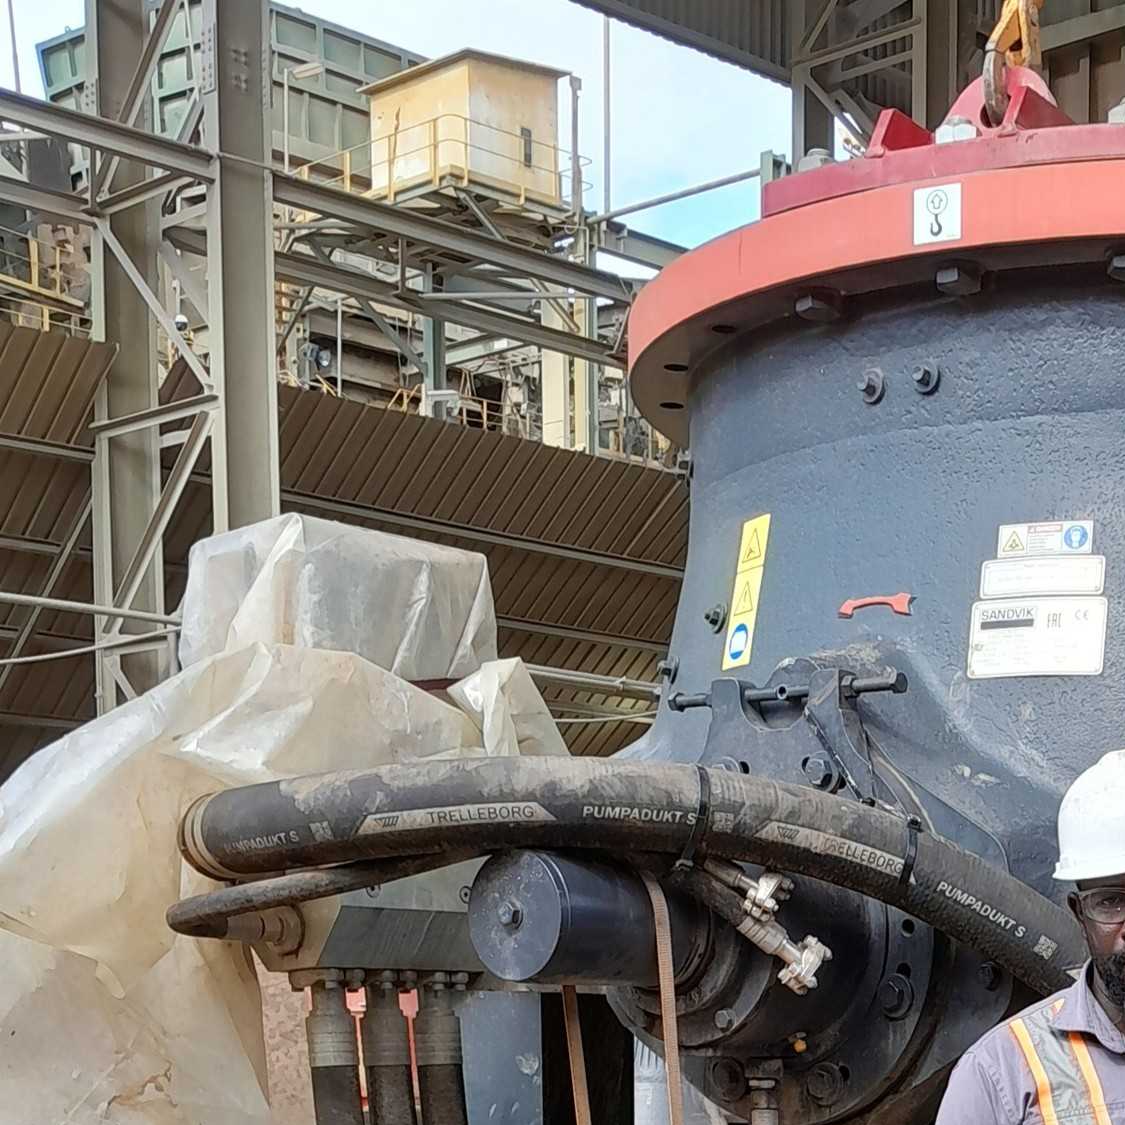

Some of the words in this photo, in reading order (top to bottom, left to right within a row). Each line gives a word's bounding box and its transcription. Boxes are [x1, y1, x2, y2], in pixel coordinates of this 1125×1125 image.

[982, 607, 1034, 620] SANDVIK
[426, 805, 535, 825] TRELLEBORG
[582, 805, 683, 823] PUMPADUKT
[686, 812, 697, 826] S
[289, 830, 299, 842] S
[936, 881, 1017, 932] PUMPADUKT
[1015, 925, 1027, 938] S
